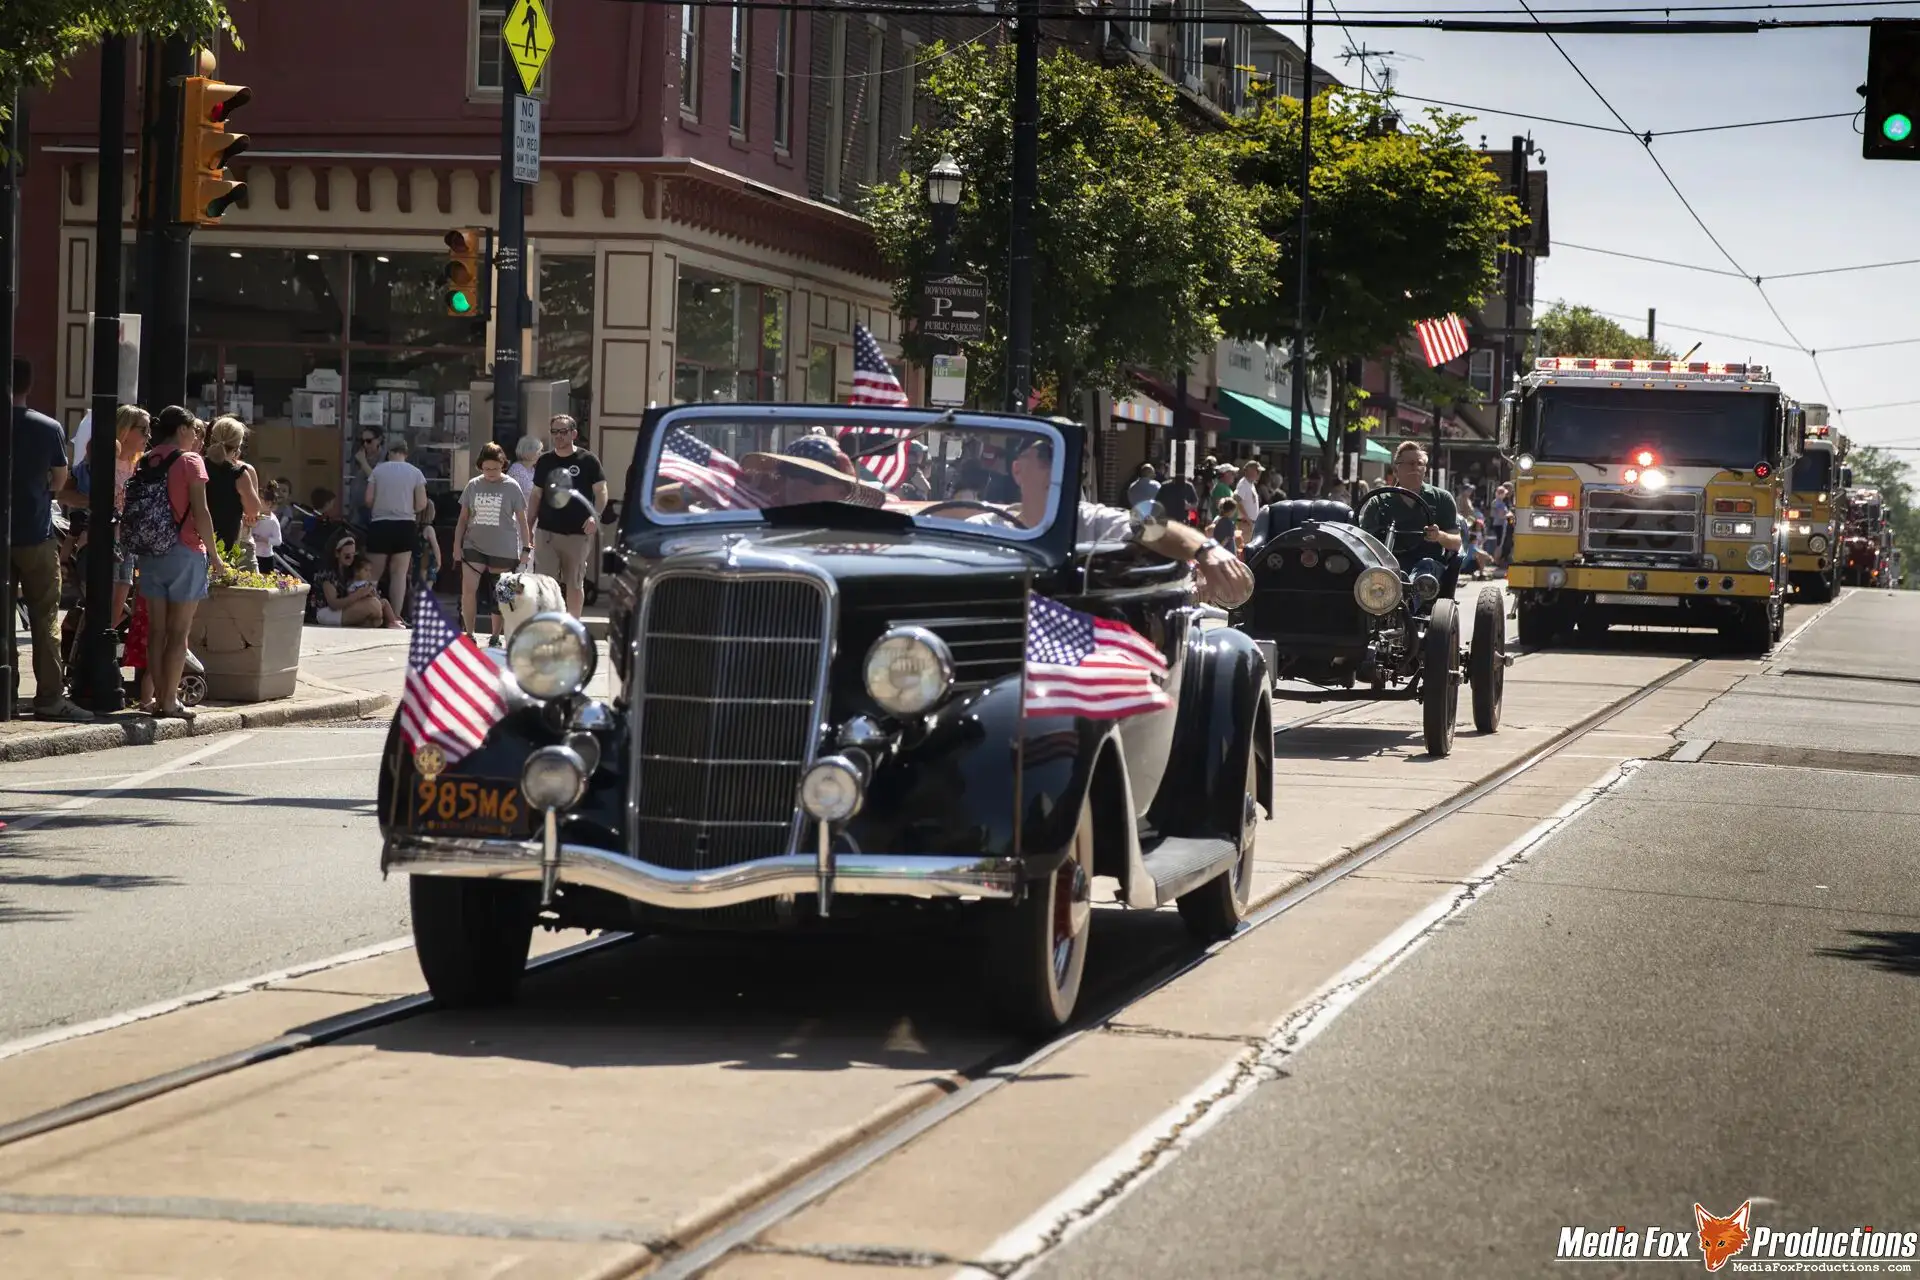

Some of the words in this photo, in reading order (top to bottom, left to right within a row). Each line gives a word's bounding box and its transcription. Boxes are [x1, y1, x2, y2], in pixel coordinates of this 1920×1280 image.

[521, 101, 534, 118] NO
[520, 120, 536, 134] TURN
[516, 136, 525, 149] ON
[526, 138, 538, 152] RED
[924, 285, 962, 297] DOWNTOWN
[962, 287, 983, 298] MEDIA
[931, 297, 953, 317] P
[924, 320, 950, 332] PUBLIC
[950, 322, 981, 333] PARKING
[418, 779, 519, 824] 985M6
